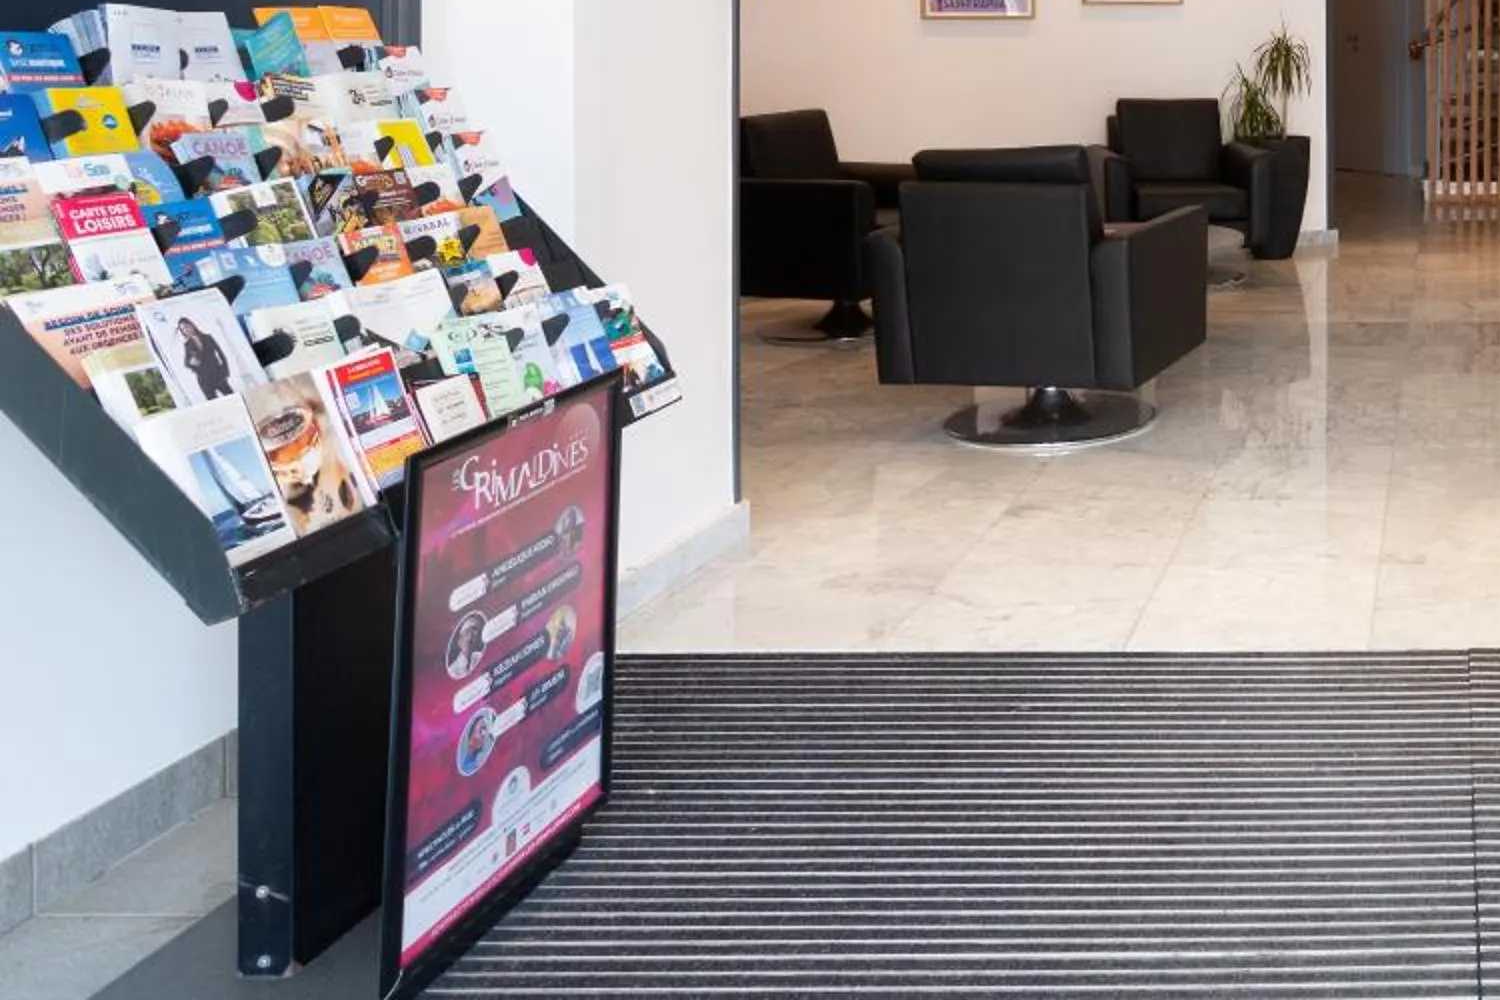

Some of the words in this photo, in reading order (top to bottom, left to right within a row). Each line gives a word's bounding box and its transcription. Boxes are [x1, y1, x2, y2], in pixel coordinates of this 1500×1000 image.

[69, 206, 106, 220] CARTE
[107, 203, 130, 216] DES
[75, 214, 136, 235] LOISIRS
